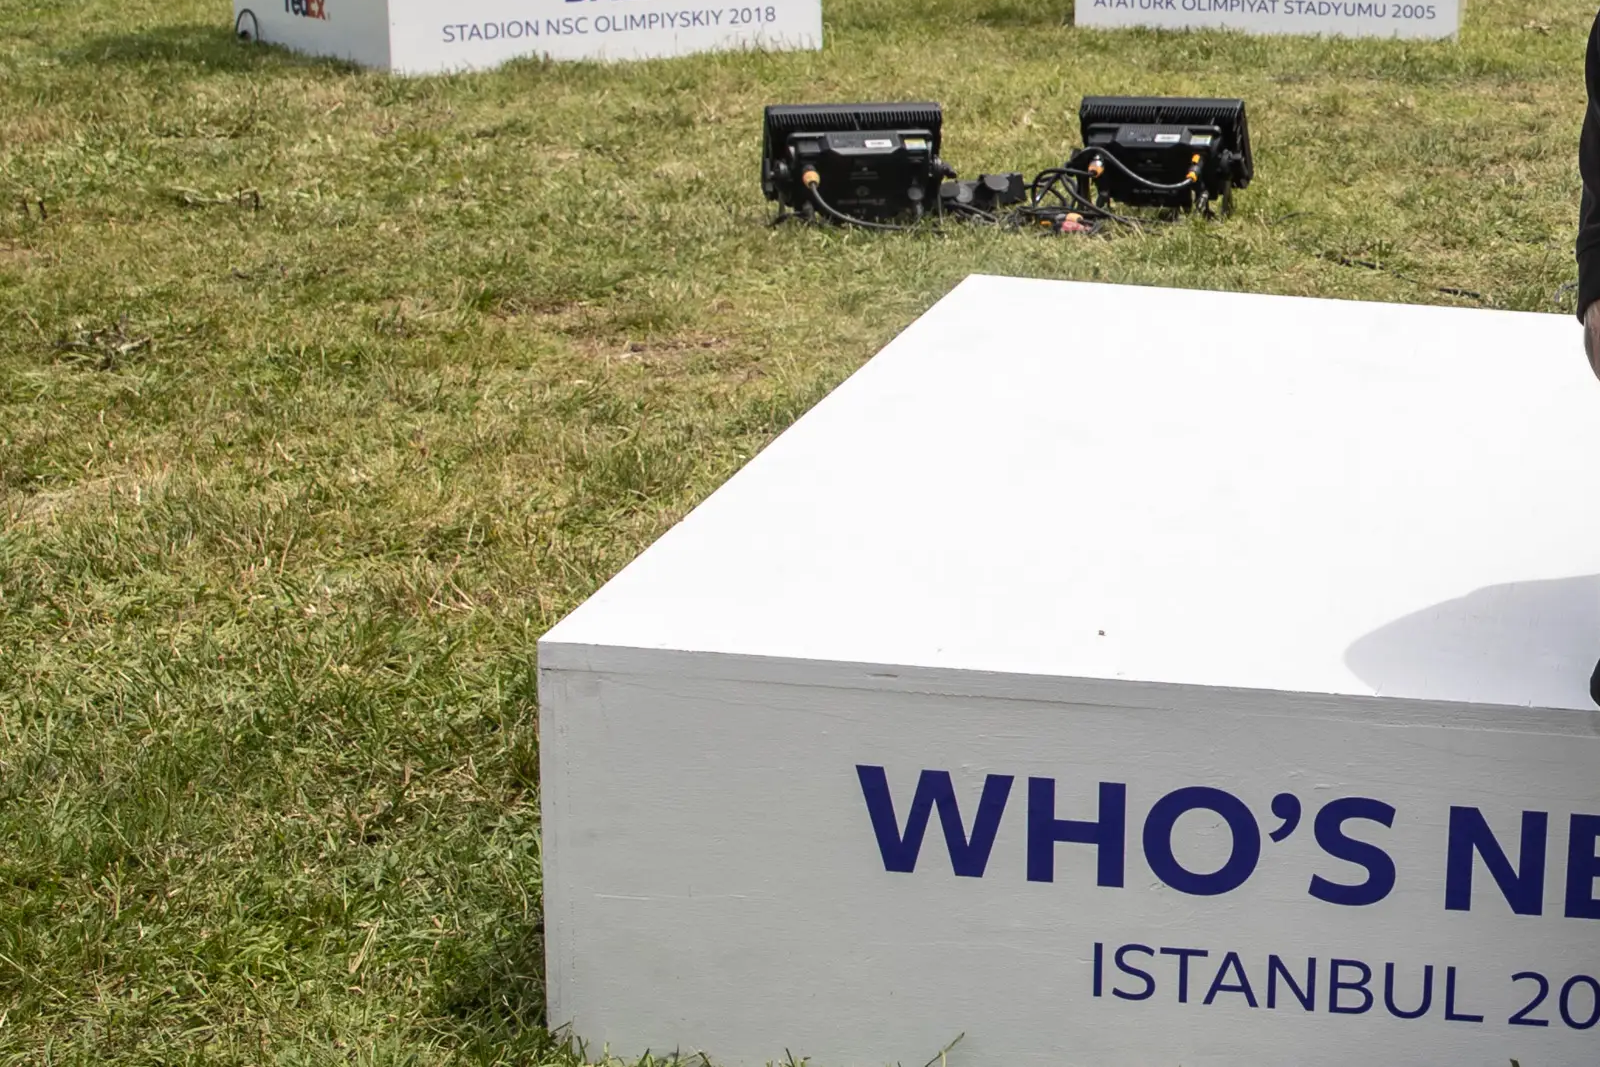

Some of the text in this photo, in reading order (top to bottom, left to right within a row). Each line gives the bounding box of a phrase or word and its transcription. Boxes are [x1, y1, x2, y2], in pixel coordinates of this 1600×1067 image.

[442, 5, 777, 43] STADION NSC OLIMPIYSKIY 2018
[1283, 0, 1387, 18] STADYUMU
[1391, 3, 1437, 20] 2005
[855, 764, 1398, 907] WHO'S
[1092, 941, 1484, 1024] ISTANBUL
